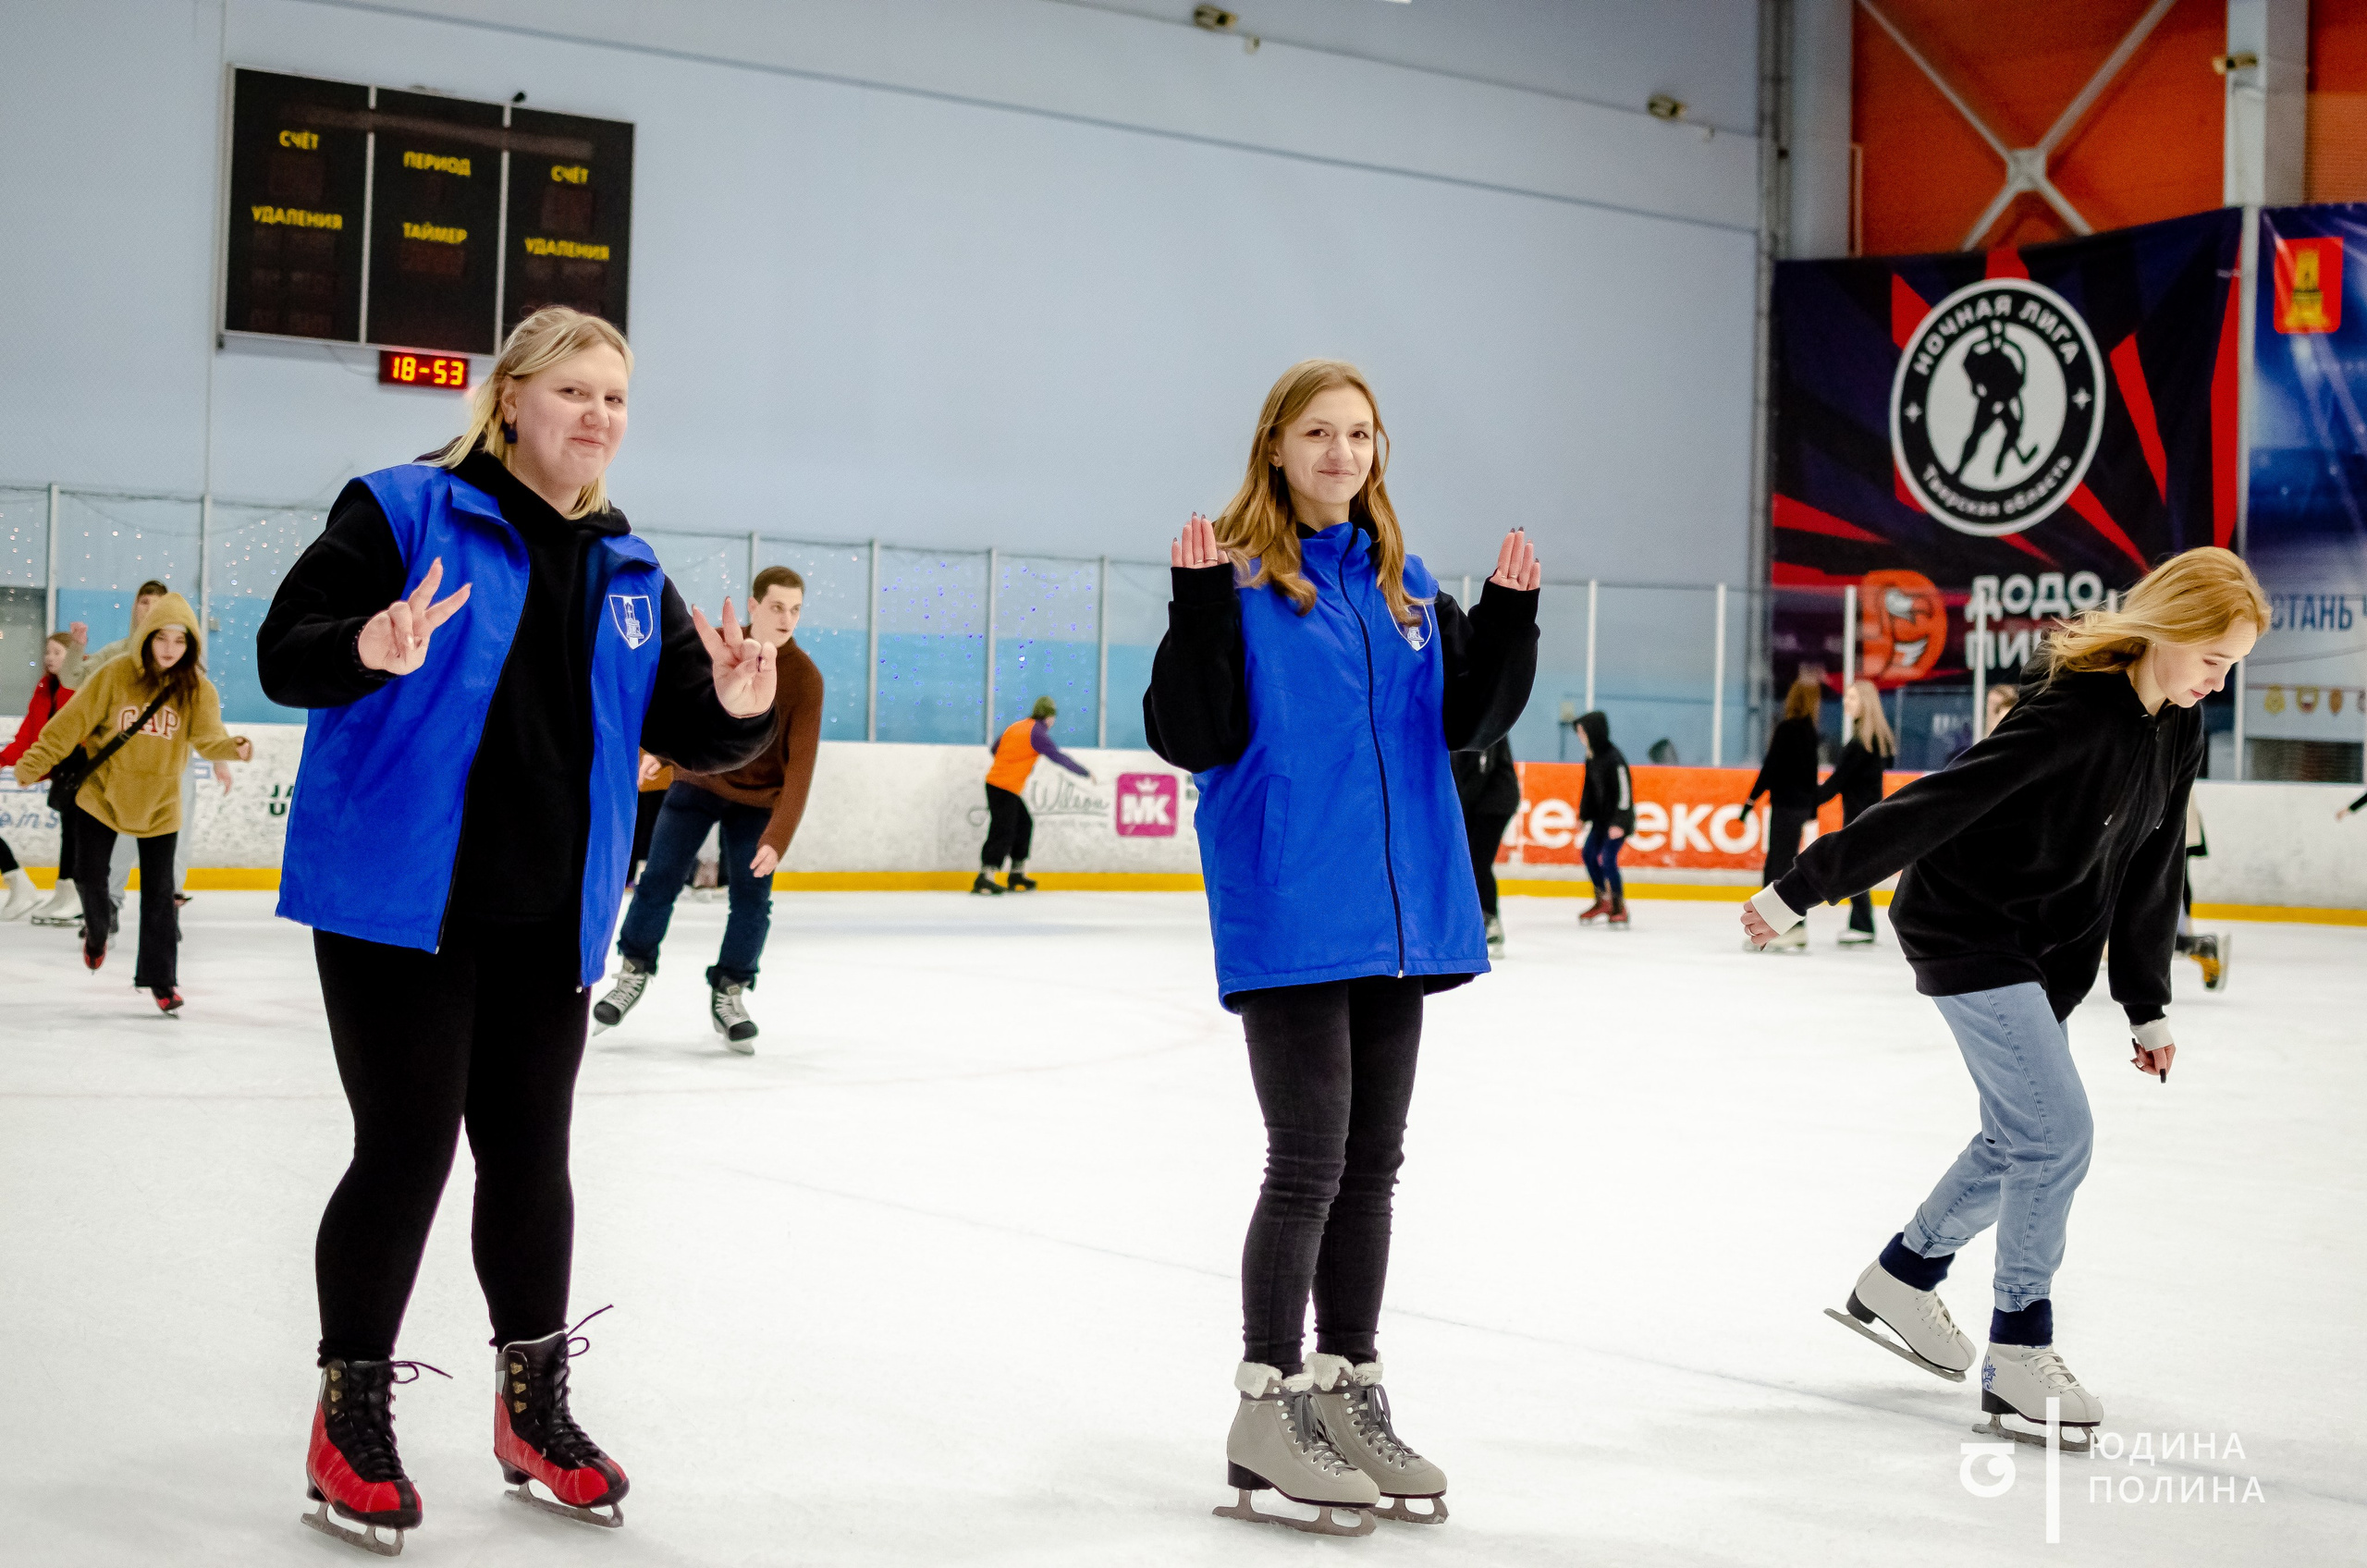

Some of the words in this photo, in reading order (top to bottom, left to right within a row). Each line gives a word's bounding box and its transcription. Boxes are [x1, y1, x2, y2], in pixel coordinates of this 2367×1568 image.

[403, 151, 472, 177] ПЕРИОД
[251, 204, 343, 230] УДАЛЕНИЯ
[402, 221, 468, 244] ТАЙМЕР
[524, 237, 610, 262] УДАЛЕНИЯ
[1913, 293, 2013, 375] НОЧНАЯ
[2017, 299, 2079, 364] ЛИГА
[392, 356, 465, 386] 18-53
[1964, 570, 2104, 622] ДОДО
